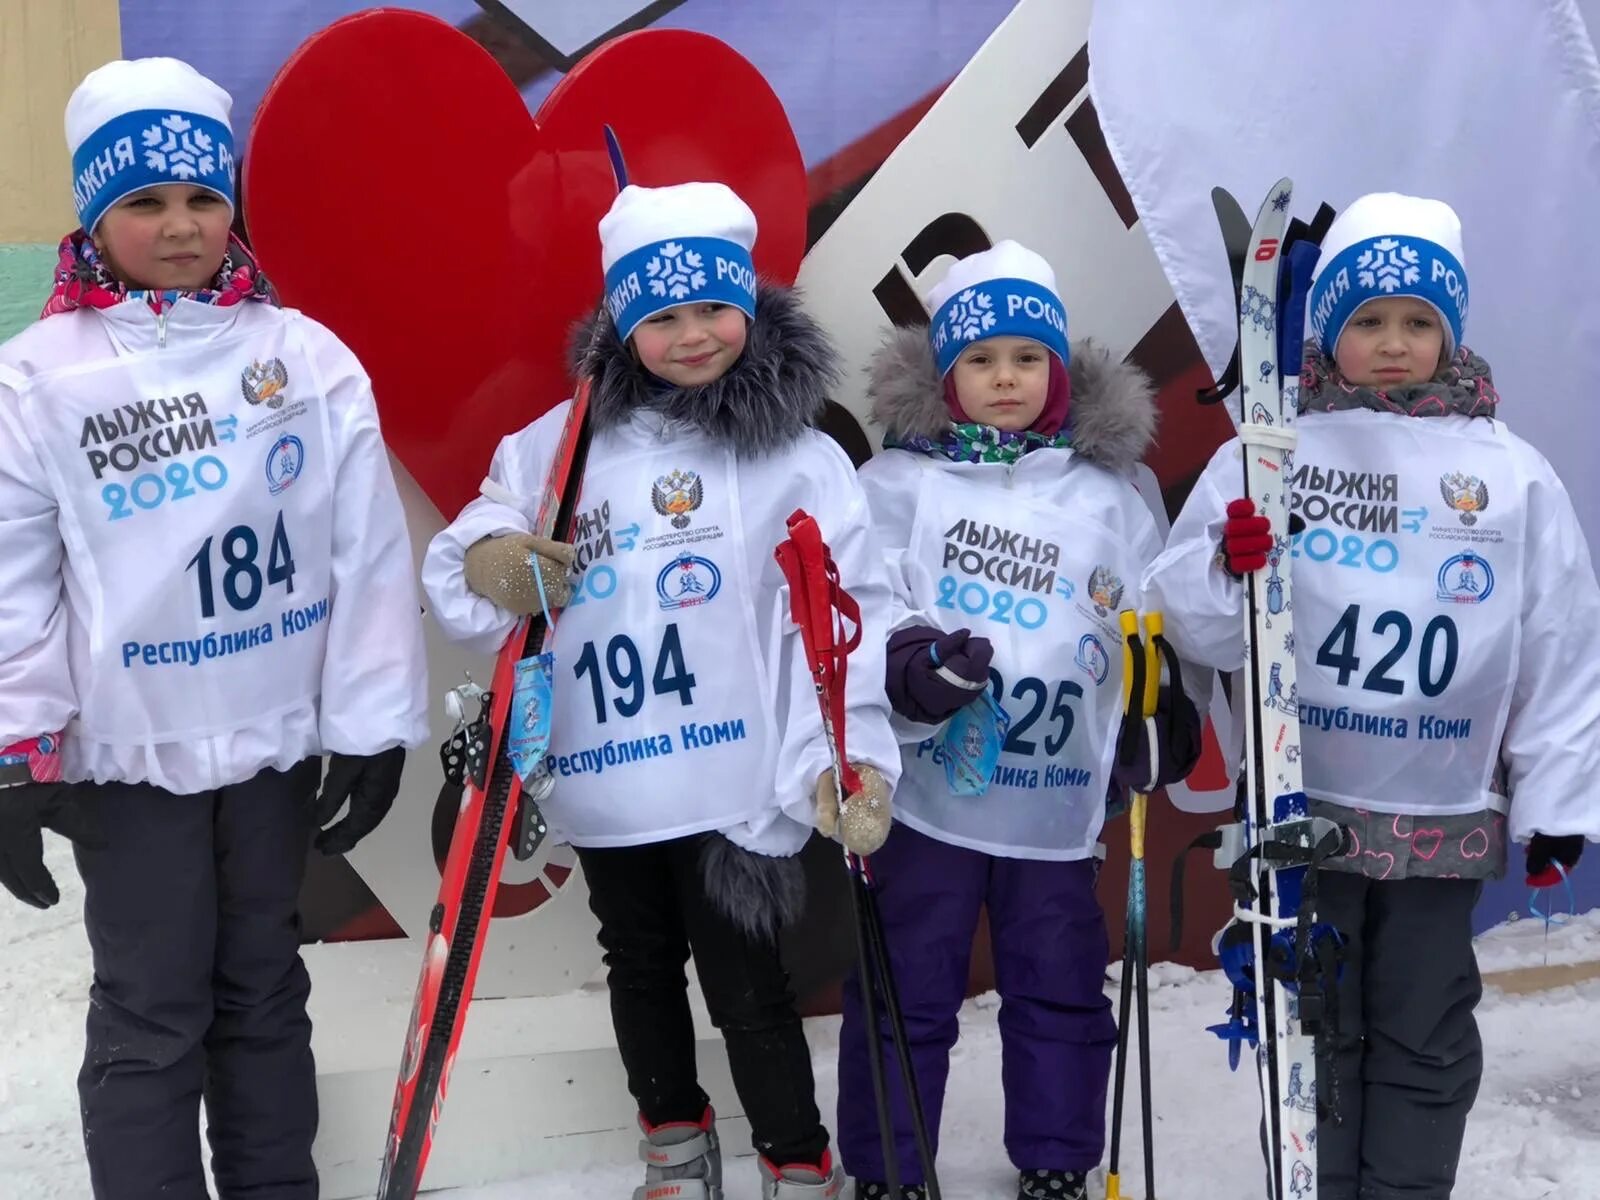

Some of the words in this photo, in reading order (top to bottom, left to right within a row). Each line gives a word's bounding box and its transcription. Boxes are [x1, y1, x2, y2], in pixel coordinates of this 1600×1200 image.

[80, 392, 208, 448] ЛЫЖНЯ
[87, 419, 217, 479] РОССИИ
[102, 455, 228, 521] 2020
[1291, 464, 1398, 502] ЛЫЖНЯ
[185, 509, 296, 618] 184
[942, 542, 1056, 595] РОССИИ
[944, 518, 1060, 567] ЛЫЖНЯ
[935, 575, 1048, 630] 2020
[122, 626, 273, 668] Республика
[281, 598, 328, 638] Коми
[1316, 604, 1459, 697] 420
[573, 623, 696, 724] 194
[546, 734, 673, 776] Республика
[680, 719, 746, 750] Коми
[1299, 703, 1408, 738] спублика
[1419, 714, 1472, 740] Коми
[1044, 764, 1092, 788] Коми
